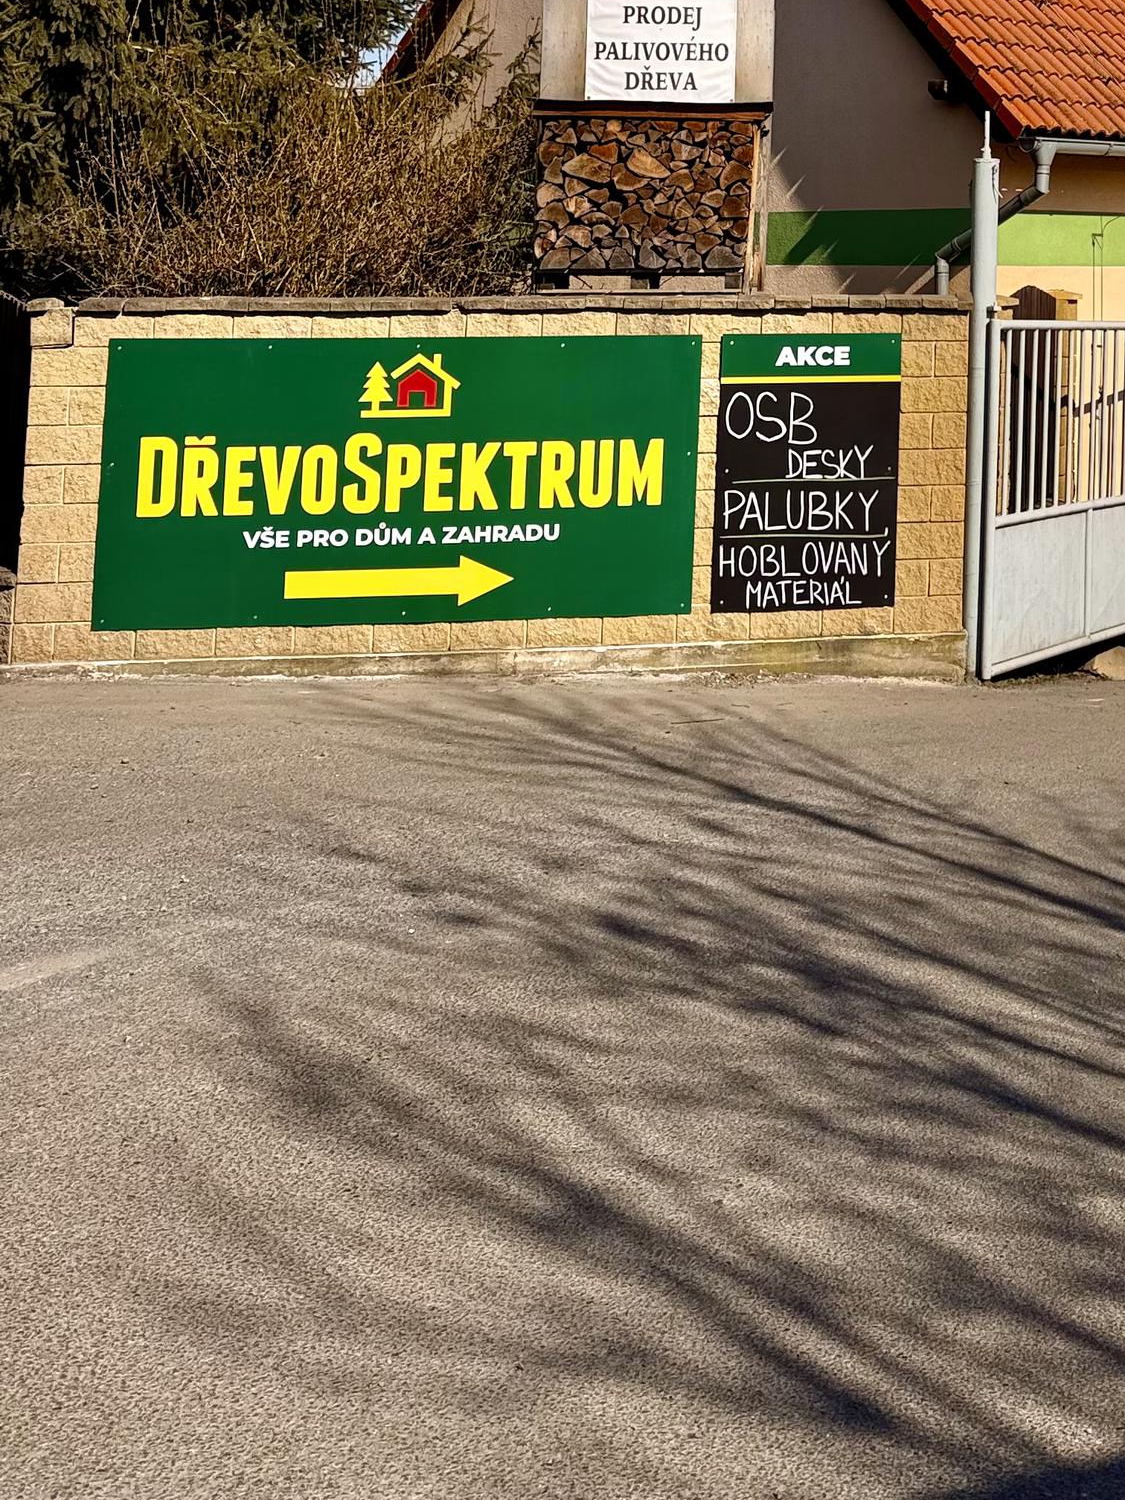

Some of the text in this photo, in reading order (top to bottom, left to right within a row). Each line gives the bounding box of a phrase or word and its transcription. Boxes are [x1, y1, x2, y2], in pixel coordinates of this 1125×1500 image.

[622, 6, 703, 31] PRODEJ
[593, 36, 729, 62] PALIVOVÉHO
[624, 66, 698, 91] DŘEVA
[775, 346, 850, 367] AKCE
[725, 391, 818, 445] OSB
[785, 445, 873, 480] DESKY
[243, 522, 561, 549] VŠE PRO DŮM A ZAHRADU
[745, 575, 862, 609] MATERIÁL
